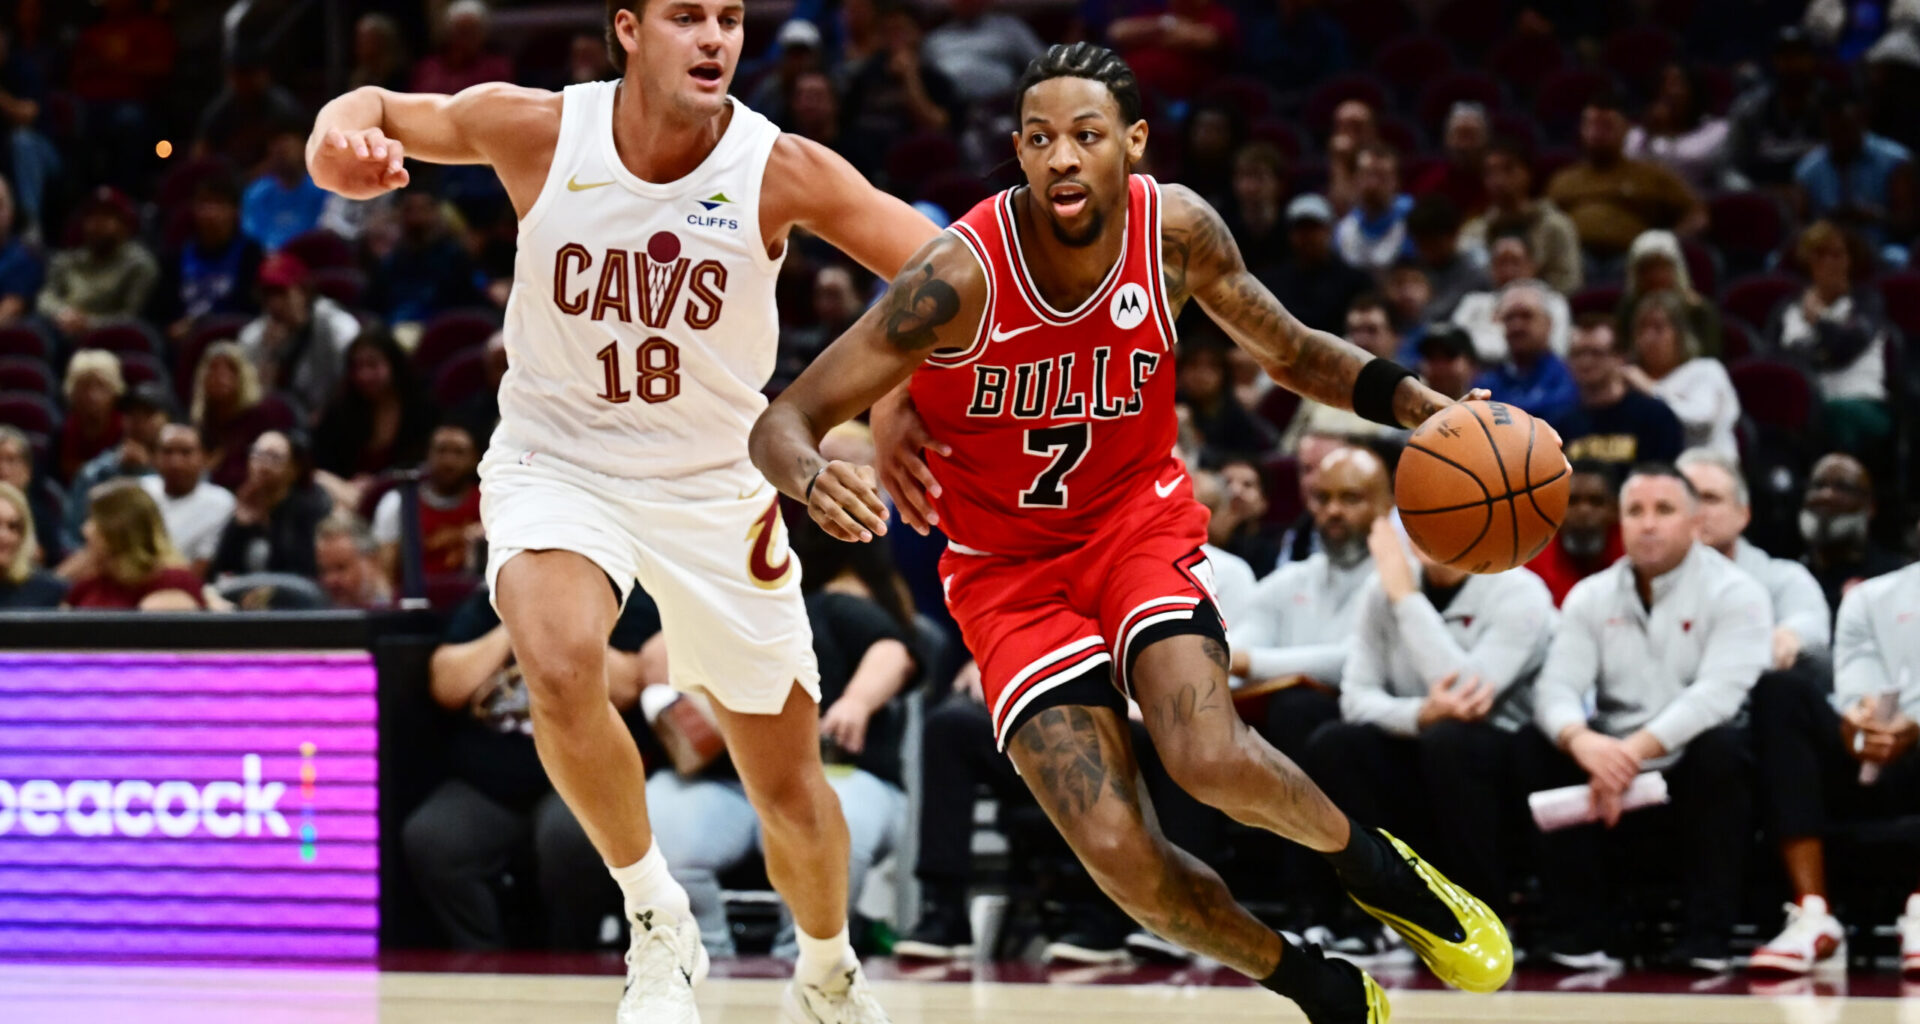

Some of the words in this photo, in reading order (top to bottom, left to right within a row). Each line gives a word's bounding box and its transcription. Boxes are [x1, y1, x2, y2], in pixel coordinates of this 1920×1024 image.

[686, 213, 739, 231] CLIFFS
[553, 241, 728, 330] CAVS
[596, 336, 681, 405] 18
[966, 345, 1161, 421] BULLS
[1018, 421, 1092, 510] 7
